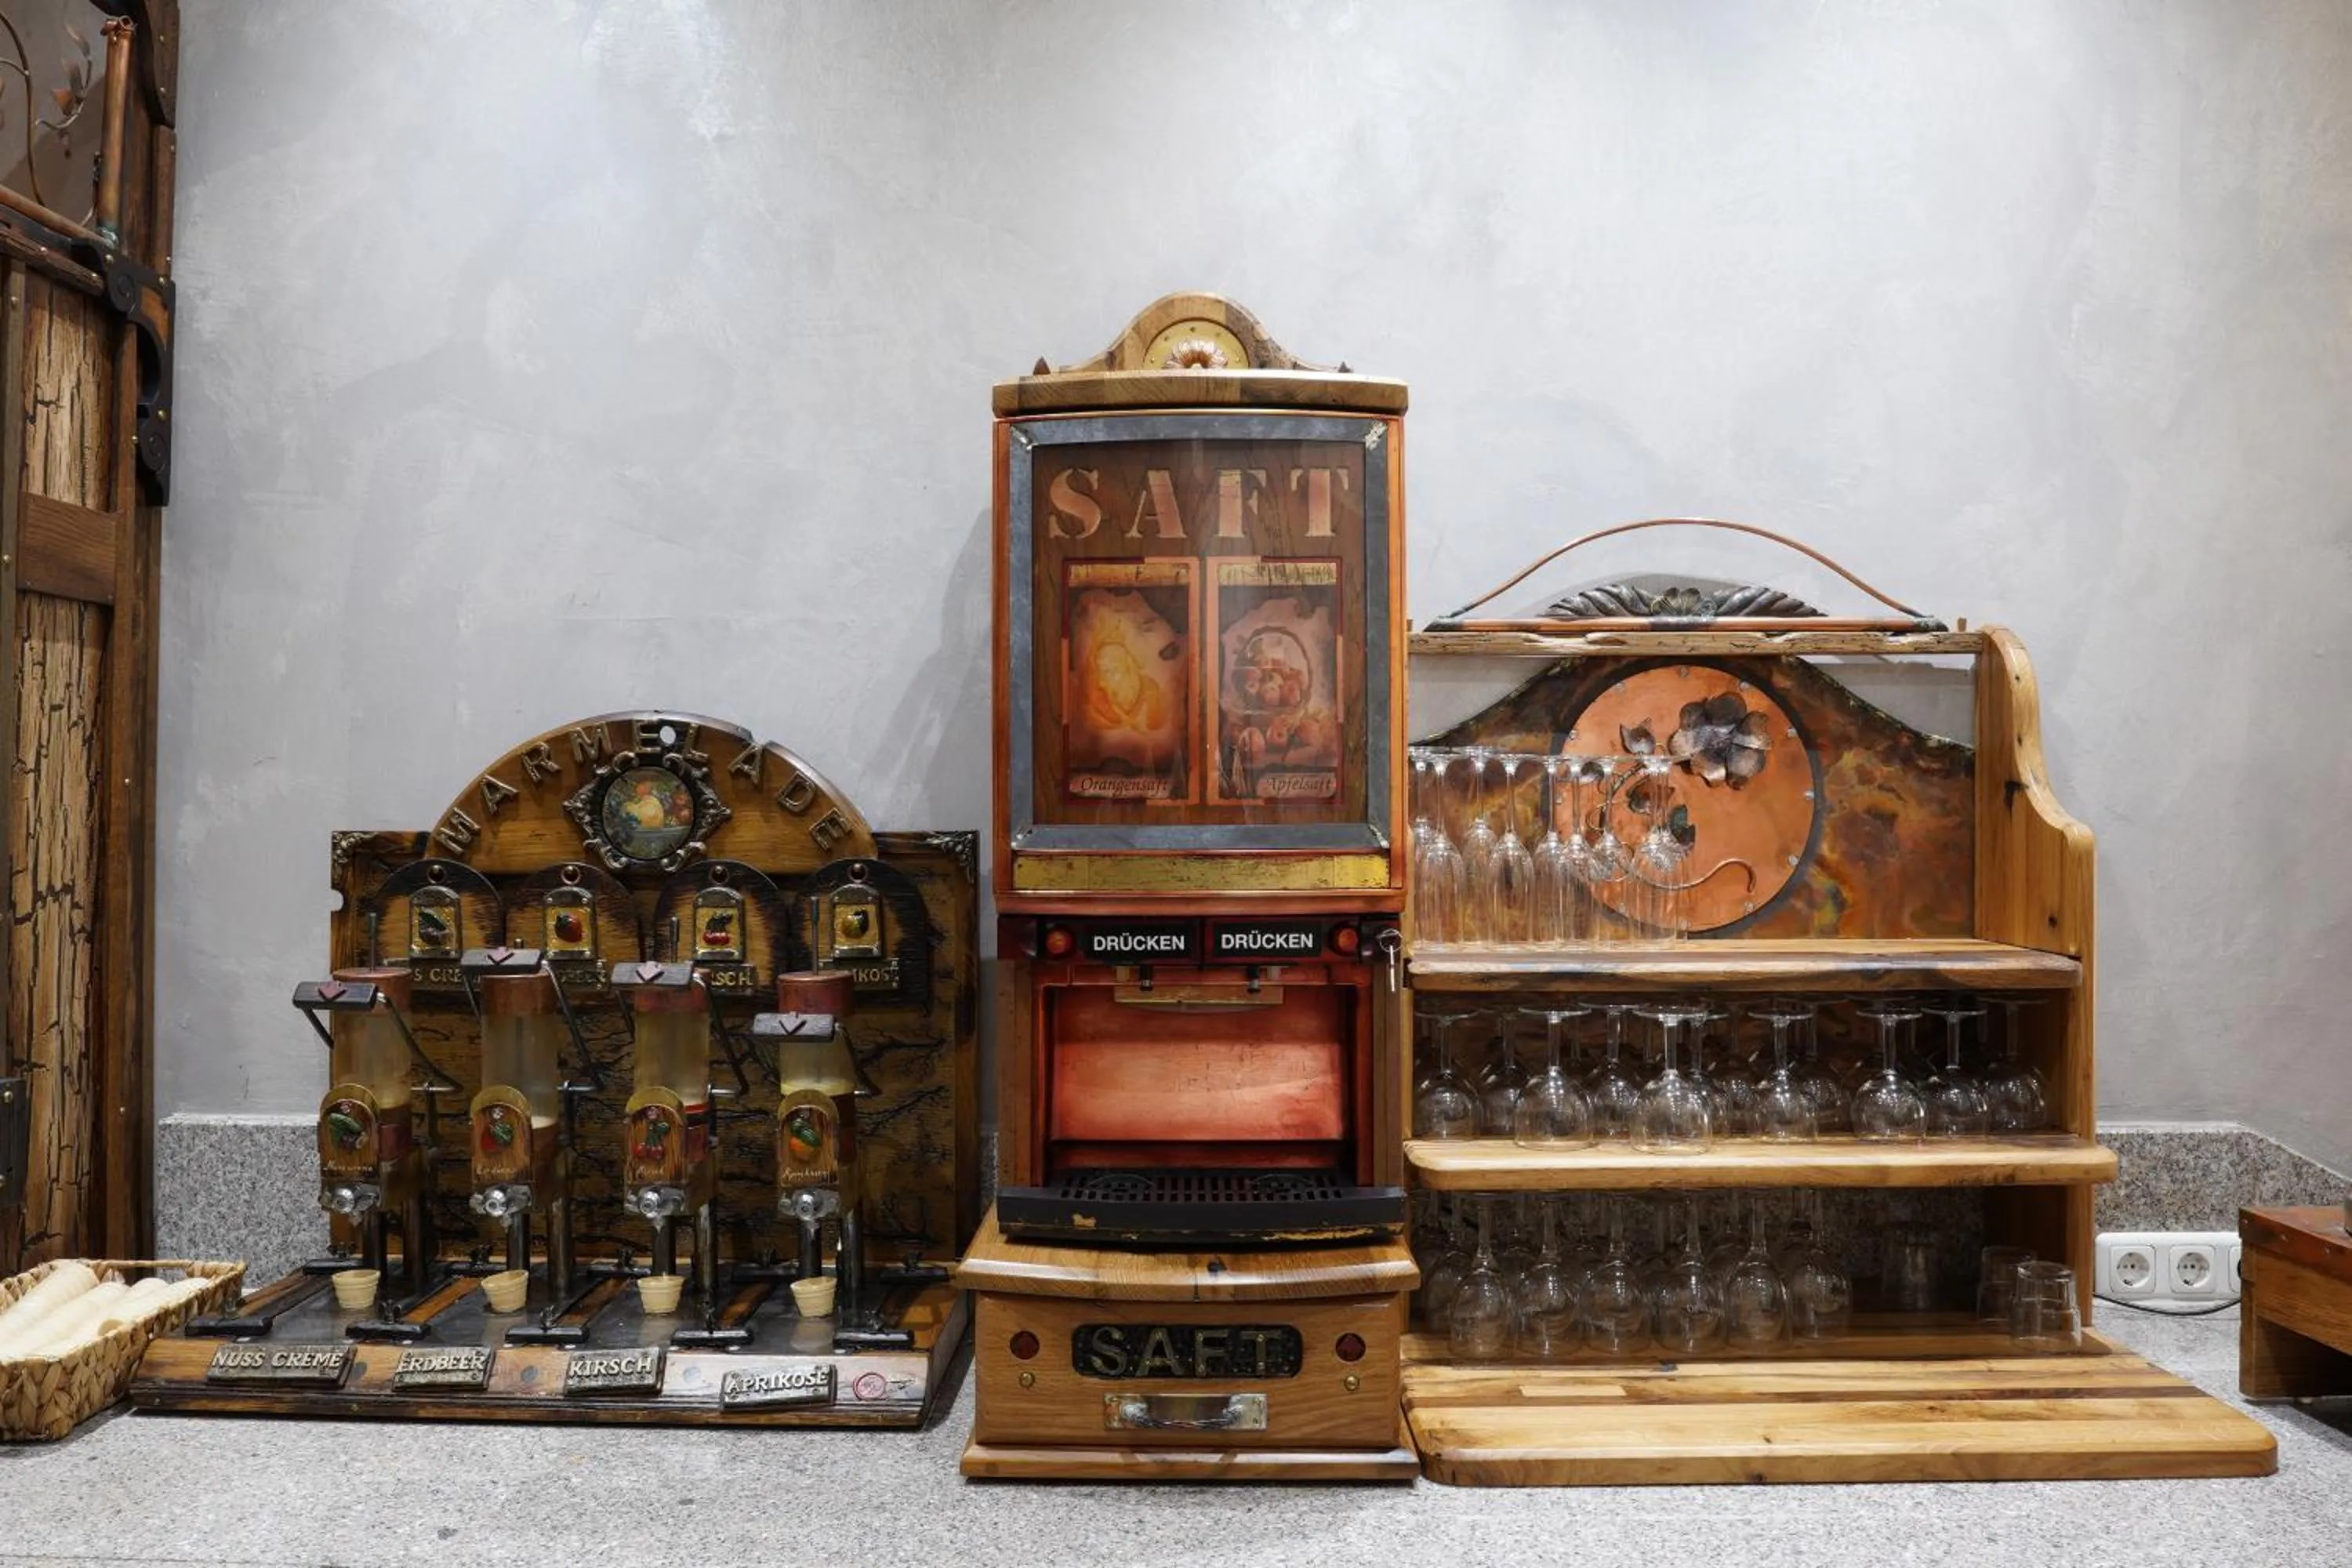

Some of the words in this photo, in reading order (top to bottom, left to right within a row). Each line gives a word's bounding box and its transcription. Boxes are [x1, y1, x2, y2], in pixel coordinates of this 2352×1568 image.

[1048, 468, 1350, 539] SAFT
[437, 719, 855, 854] MARMELADE
[1094, 933, 1185, 952] DRÜCKEN
[1221, 931, 1313, 950] DRÜCKEN
[711, 967, 753, 985] SCH
[211, 1351, 267, 1369] NUSS
[271, 1351, 343, 1369] CREME
[397, 1350, 488, 1373] ERDBEER
[1091, 1326, 1283, 1377] SAFT
[568, 1356, 654, 1377] KIRSCH
[724, 1365, 829, 1395] APRIKOSE
